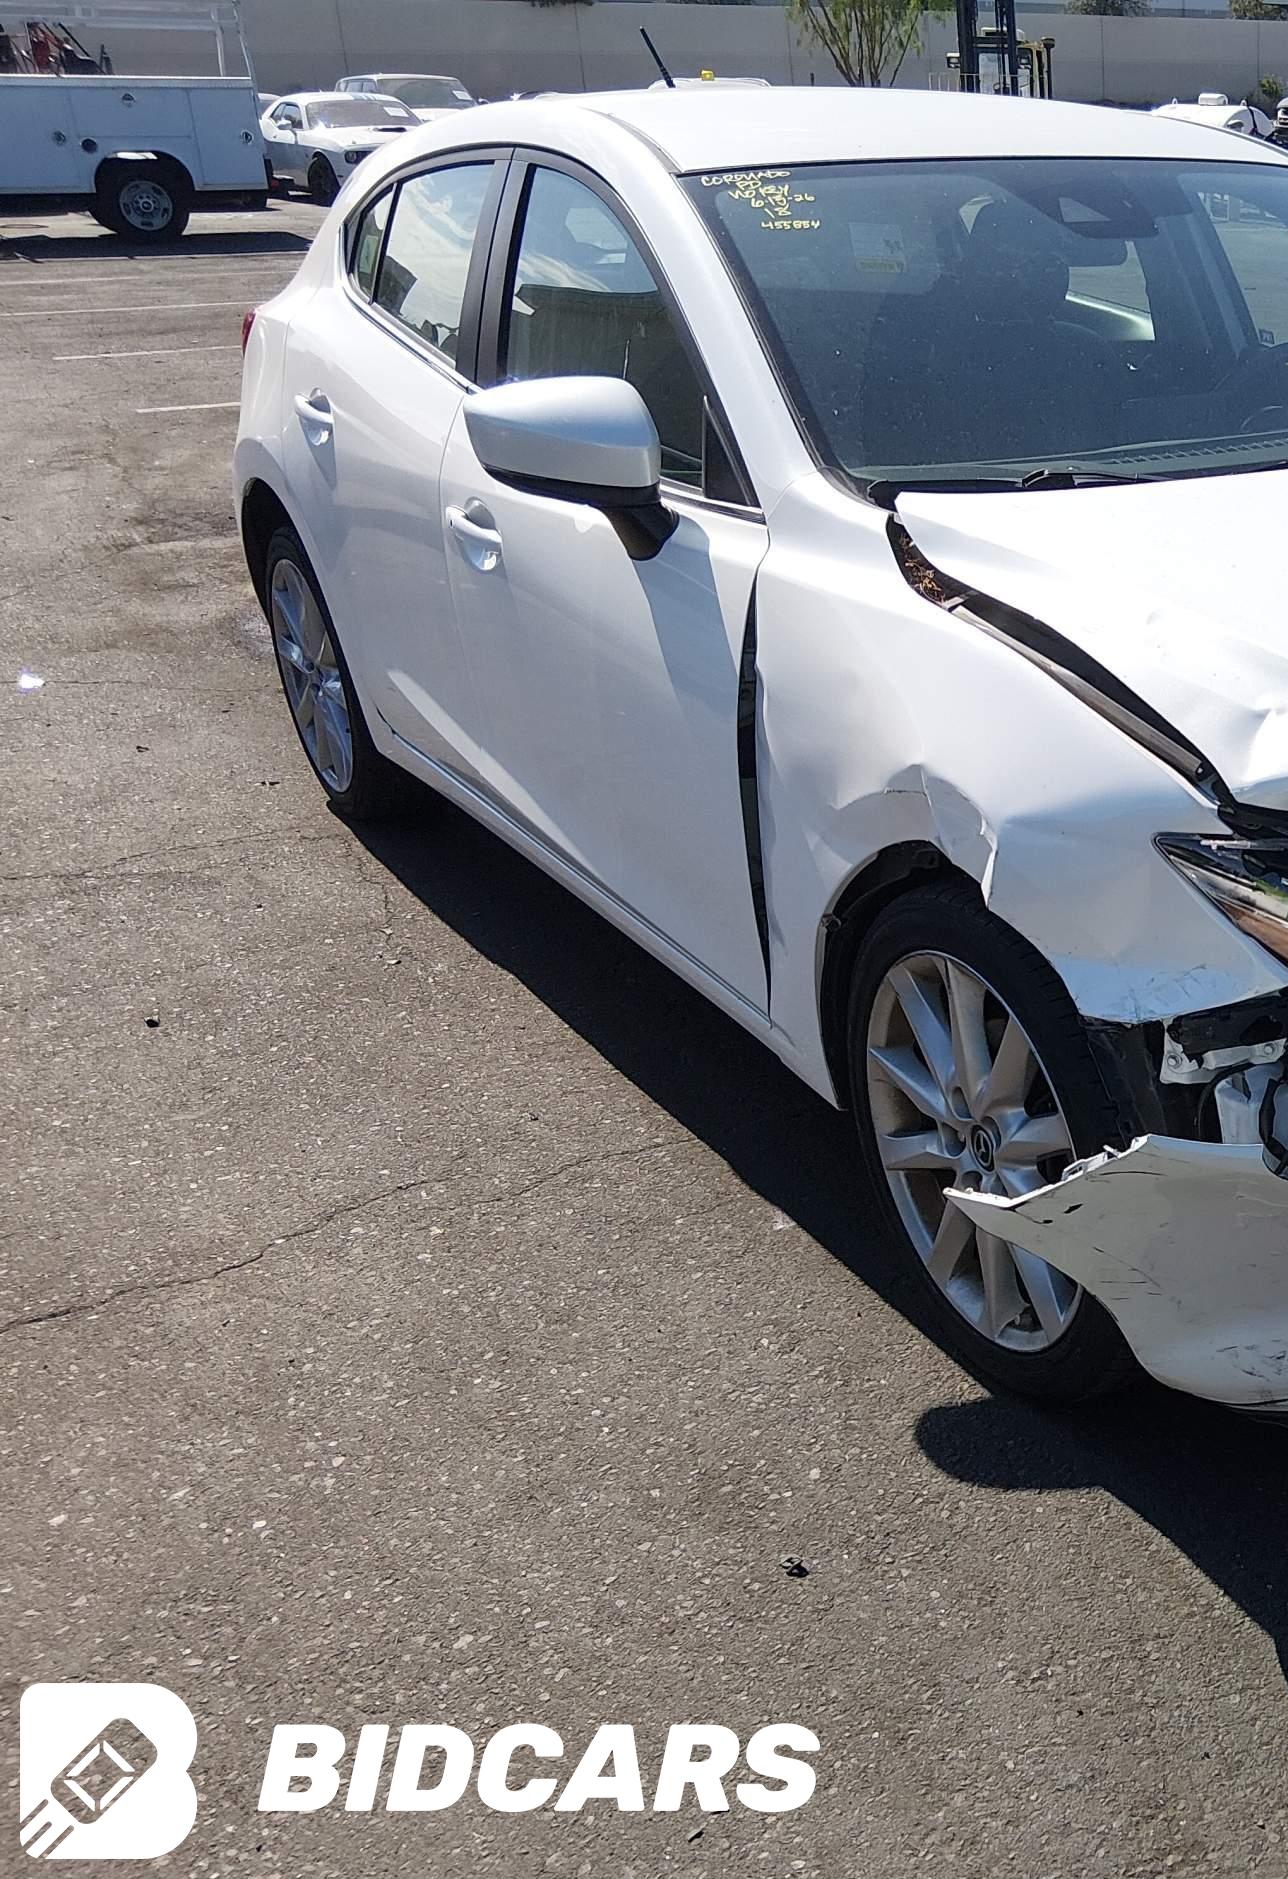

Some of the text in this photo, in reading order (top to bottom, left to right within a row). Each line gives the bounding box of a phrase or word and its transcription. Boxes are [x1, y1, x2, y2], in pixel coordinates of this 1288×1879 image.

[700, 170, 791, 187] CORONADO
[727, 184, 790, 200] NO KEY
